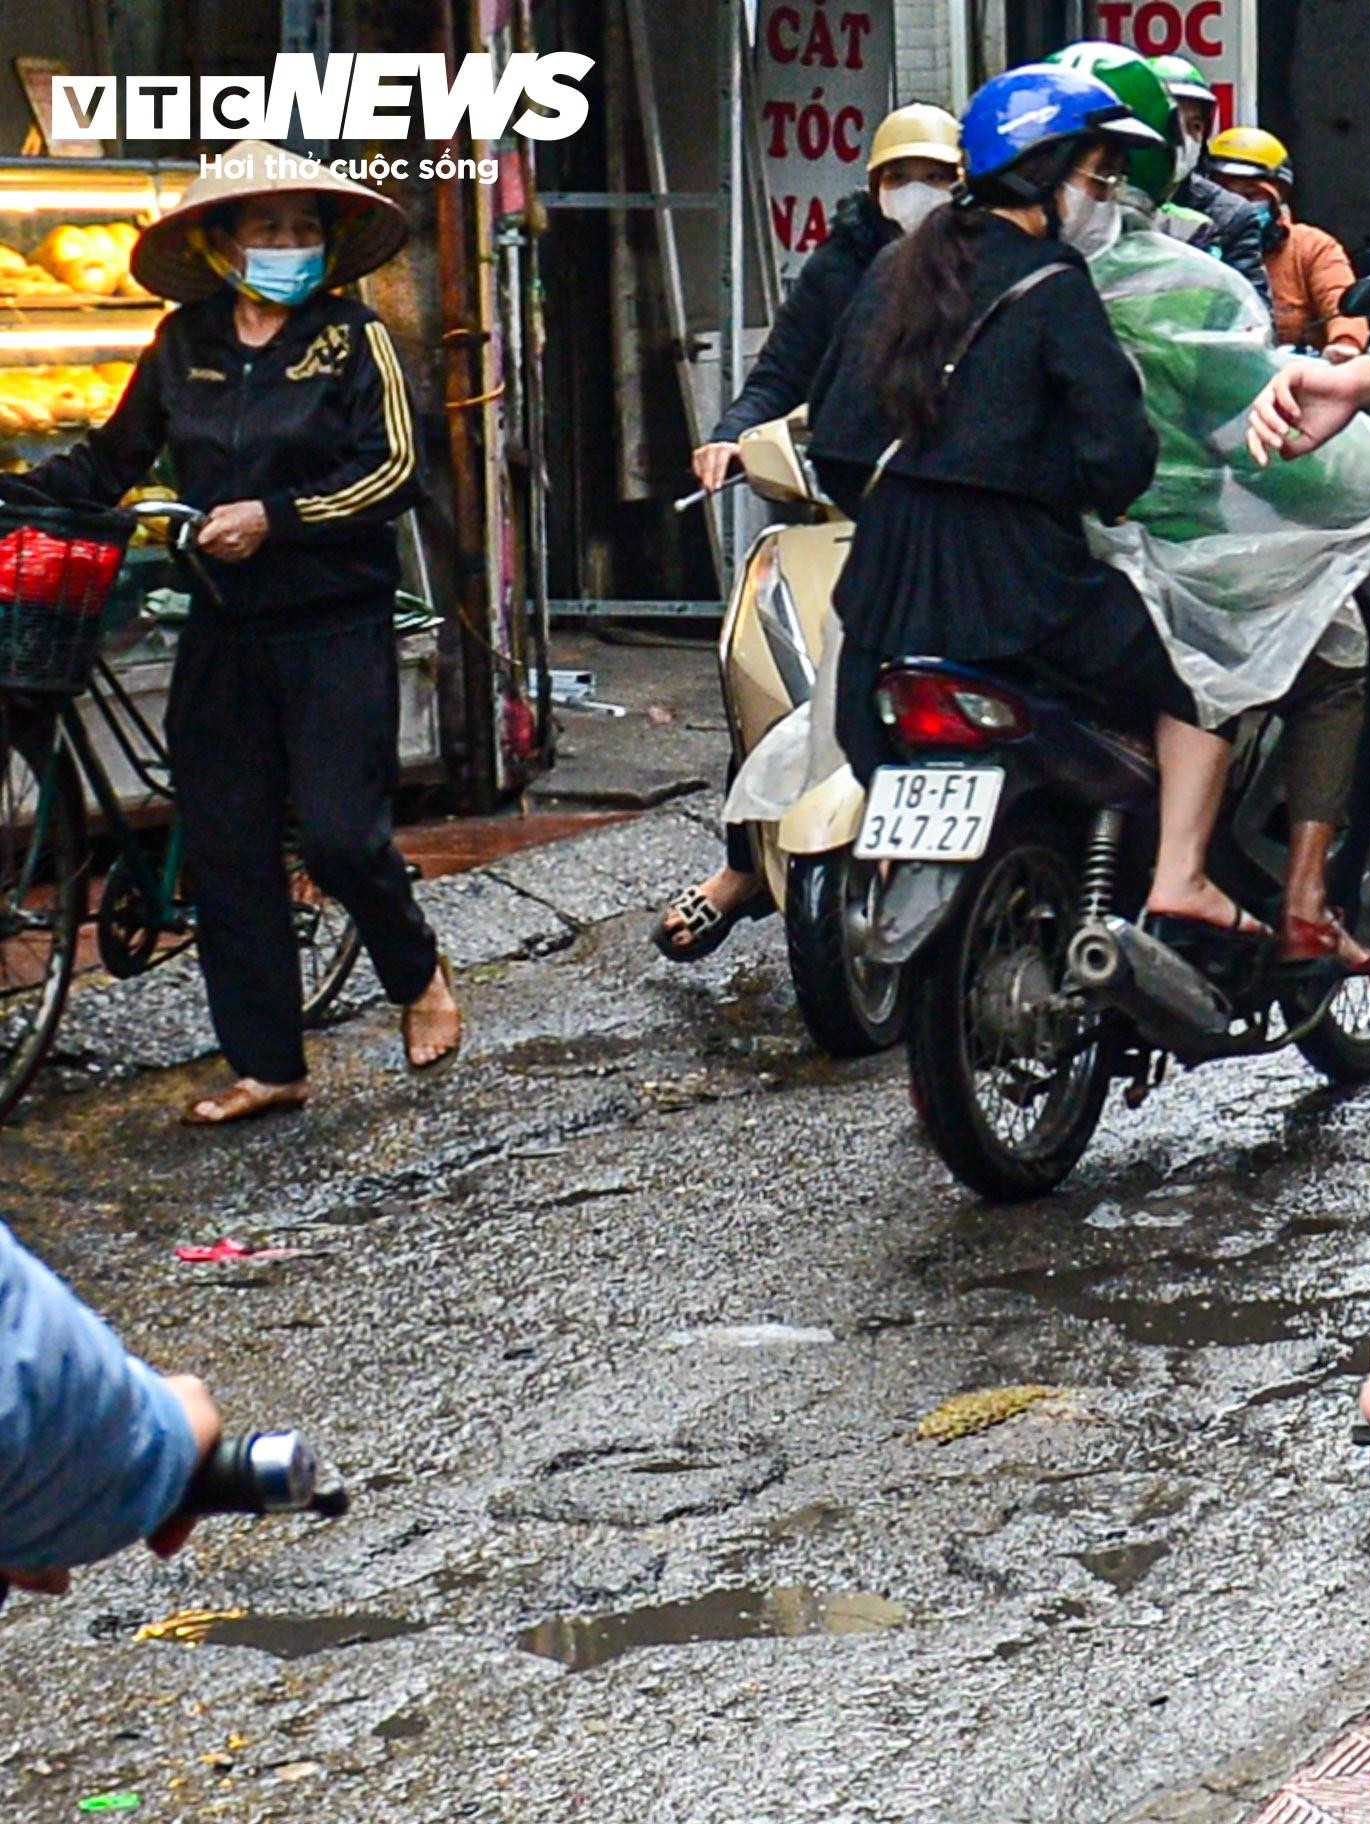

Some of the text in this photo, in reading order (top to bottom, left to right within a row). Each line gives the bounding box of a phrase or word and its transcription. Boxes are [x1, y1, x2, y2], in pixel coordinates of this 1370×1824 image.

[763, 86, 865, 163] TÓC
[894, 774, 978, 810] 18-F1
[865, 815, 982, 851] 347.27
